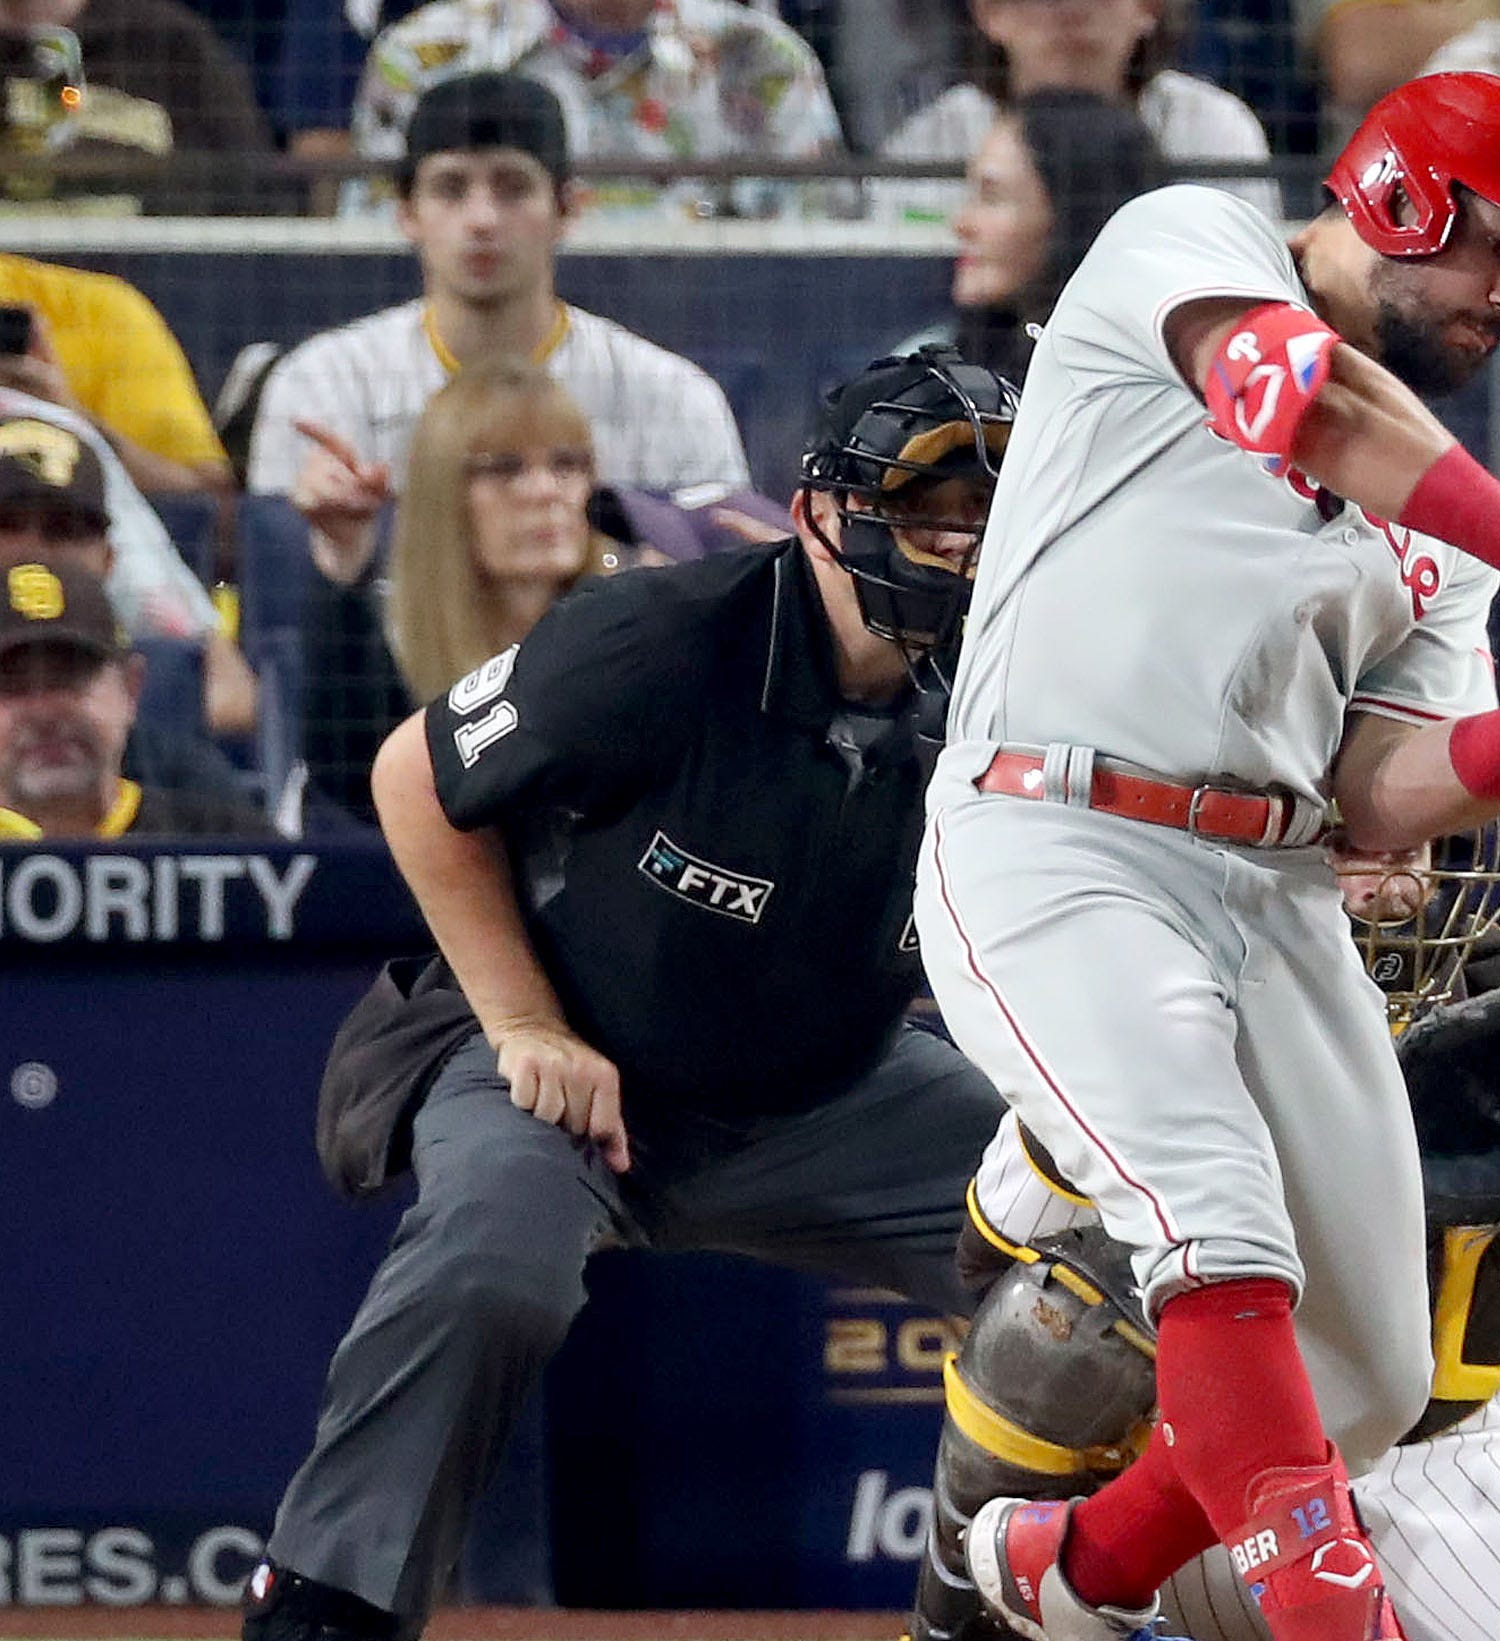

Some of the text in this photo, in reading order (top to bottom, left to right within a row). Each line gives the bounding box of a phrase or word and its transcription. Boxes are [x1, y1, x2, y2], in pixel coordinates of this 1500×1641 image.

[1227, 331, 1262, 363] P
[0, 853, 319, 943] ORITY
[677, 863, 766, 915] FTX
[823, 1315, 972, 1373] 20
[1291, 1498, 1332, 1539] 12
[0, 1525, 265, 1605] ES.C
